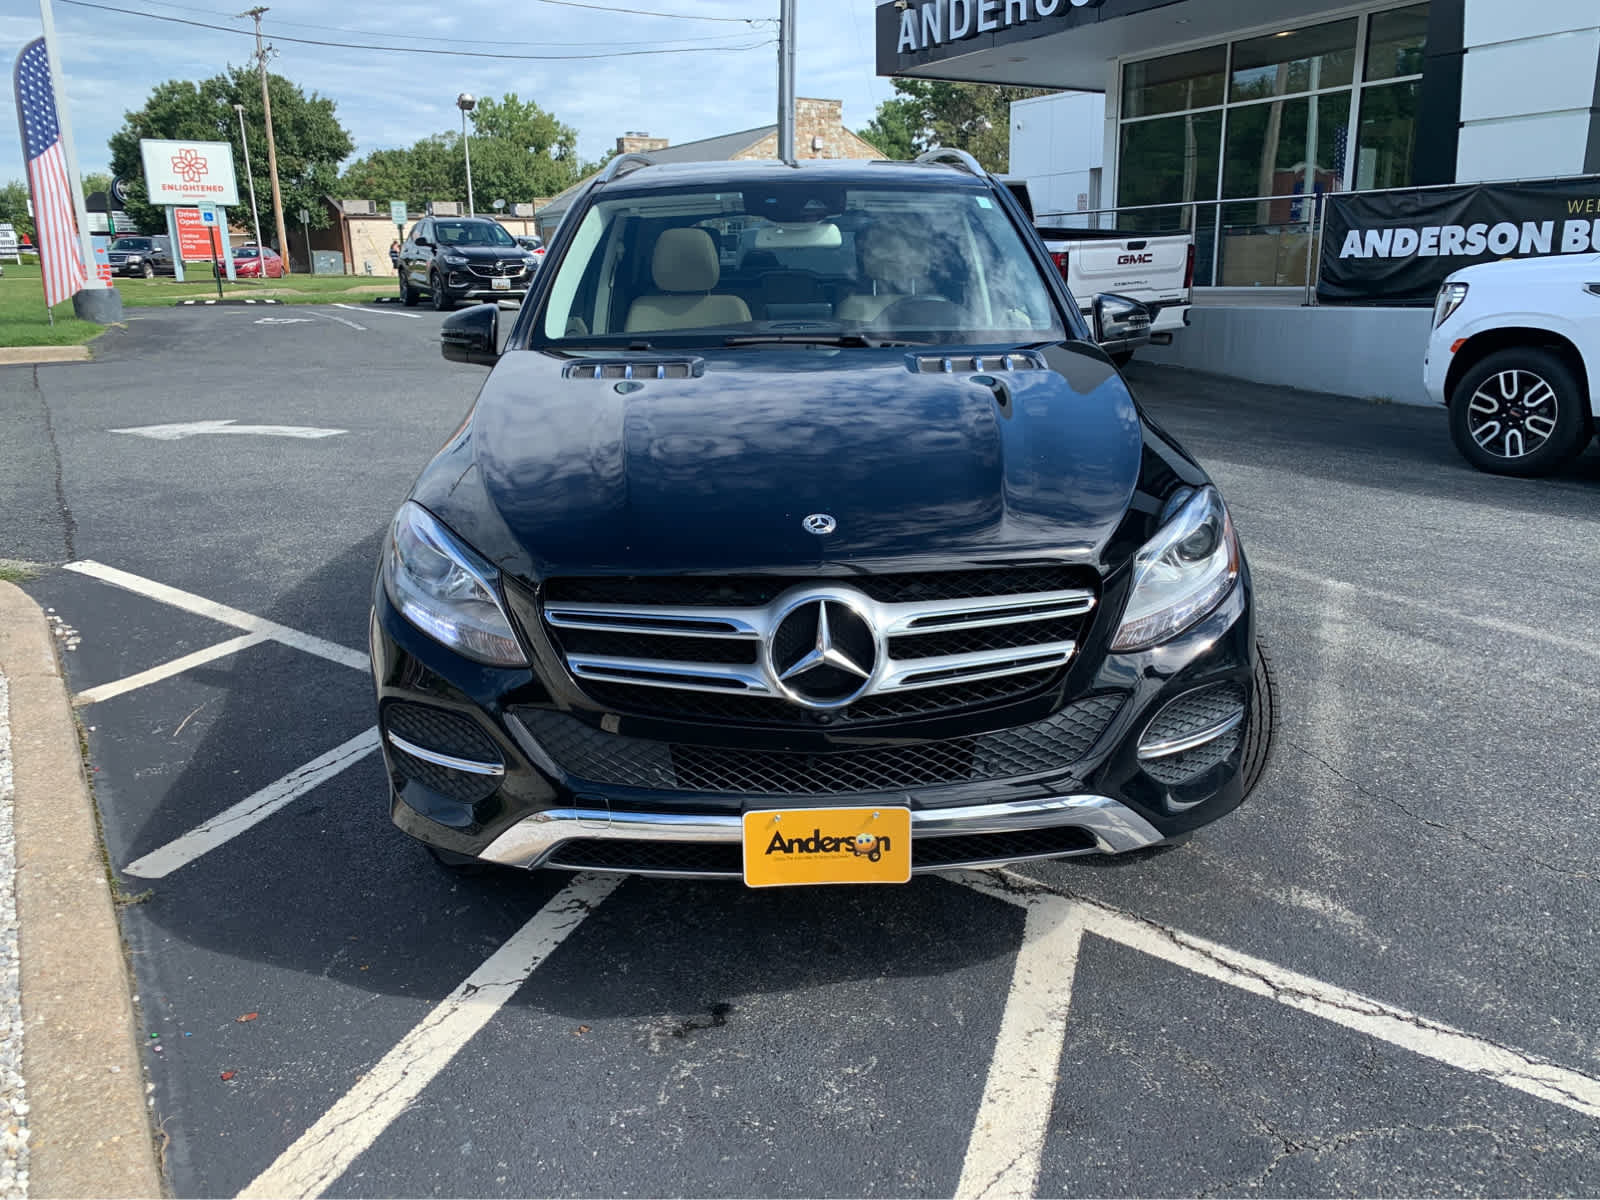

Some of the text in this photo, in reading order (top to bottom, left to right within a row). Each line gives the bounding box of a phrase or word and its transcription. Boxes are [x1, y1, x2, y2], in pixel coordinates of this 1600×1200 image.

[896, 0, 1088, 53] ANDER
[161, 183, 224, 193] ENLIGHTENED
[1339, 221, 1555, 258] ANDERSON
[1117, 253, 1153, 265] GMC
